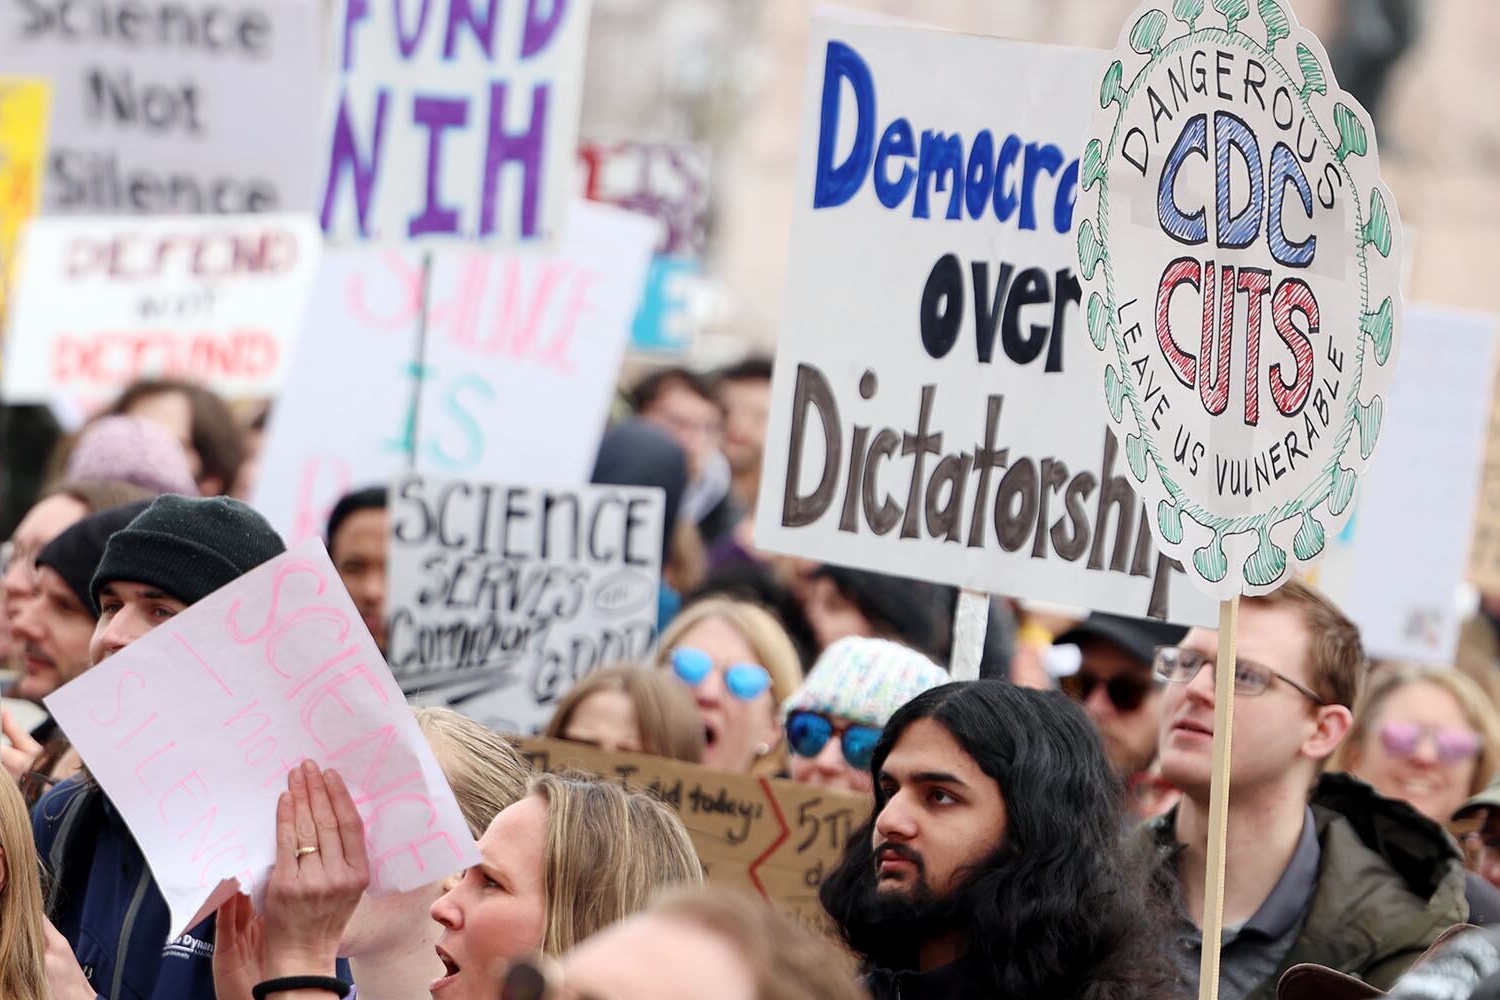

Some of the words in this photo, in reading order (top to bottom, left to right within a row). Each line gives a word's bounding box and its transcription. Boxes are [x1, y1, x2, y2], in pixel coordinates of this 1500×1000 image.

[20, 0, 273, 52] Science
[343, 0, 567, 71] FUND
[87, 70, 206, 134] Not
[320, 82, 549, 237] NIH
[1122, 51, 1343, 210] DANGEROUS
[51, 149, 280, 213] Silence
[1157, 110, 1317, 268] CDC
[920, 253, 1082, 372] over
[1154, 256, 1320, 427] CUTS
[1117, 298, 1171, 431] LEAVE
[1174, 424, 1205, 477] US
[1215, 332, 1345, 497] VULNERABLE
[394, 476, 652, 566] SCIENCE
[226, 559, 465, 891] SCIENCE
